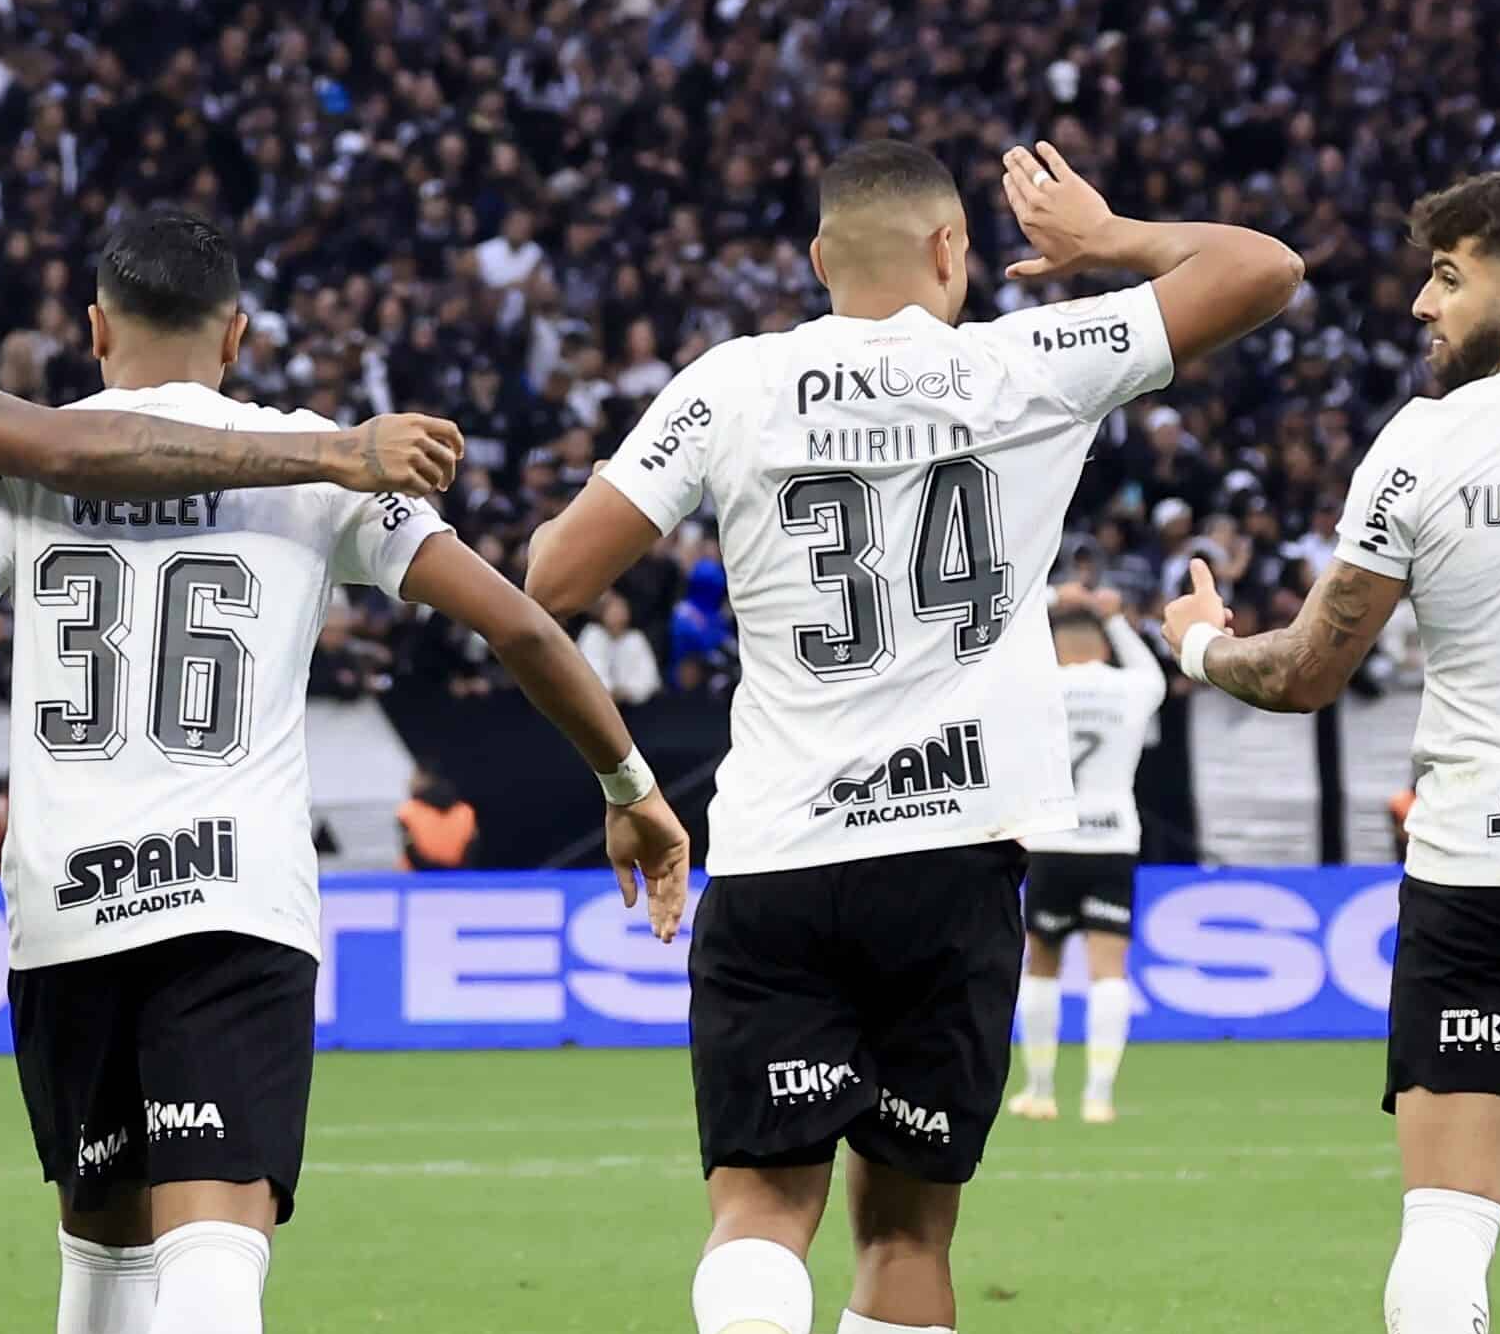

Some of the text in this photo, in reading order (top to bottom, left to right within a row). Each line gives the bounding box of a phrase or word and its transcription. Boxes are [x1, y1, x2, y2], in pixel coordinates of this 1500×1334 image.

[1056, 322, 1130, 354] bmg
[797, 355, 973, 415] pixbet
[652, 397, 712, 457] bmg
[374, 491, 412, 532] mg
[1365, 466, 1417, 534] bmg
[777, 454, 1014, 683] 34
[33, 543, 262, 767] 36
[844, 798, 962, 828] ATACADISTA
[95, 888, 206, 927] ATACADISTA
[1440, 1008, 1480, 1019] GRUPO
